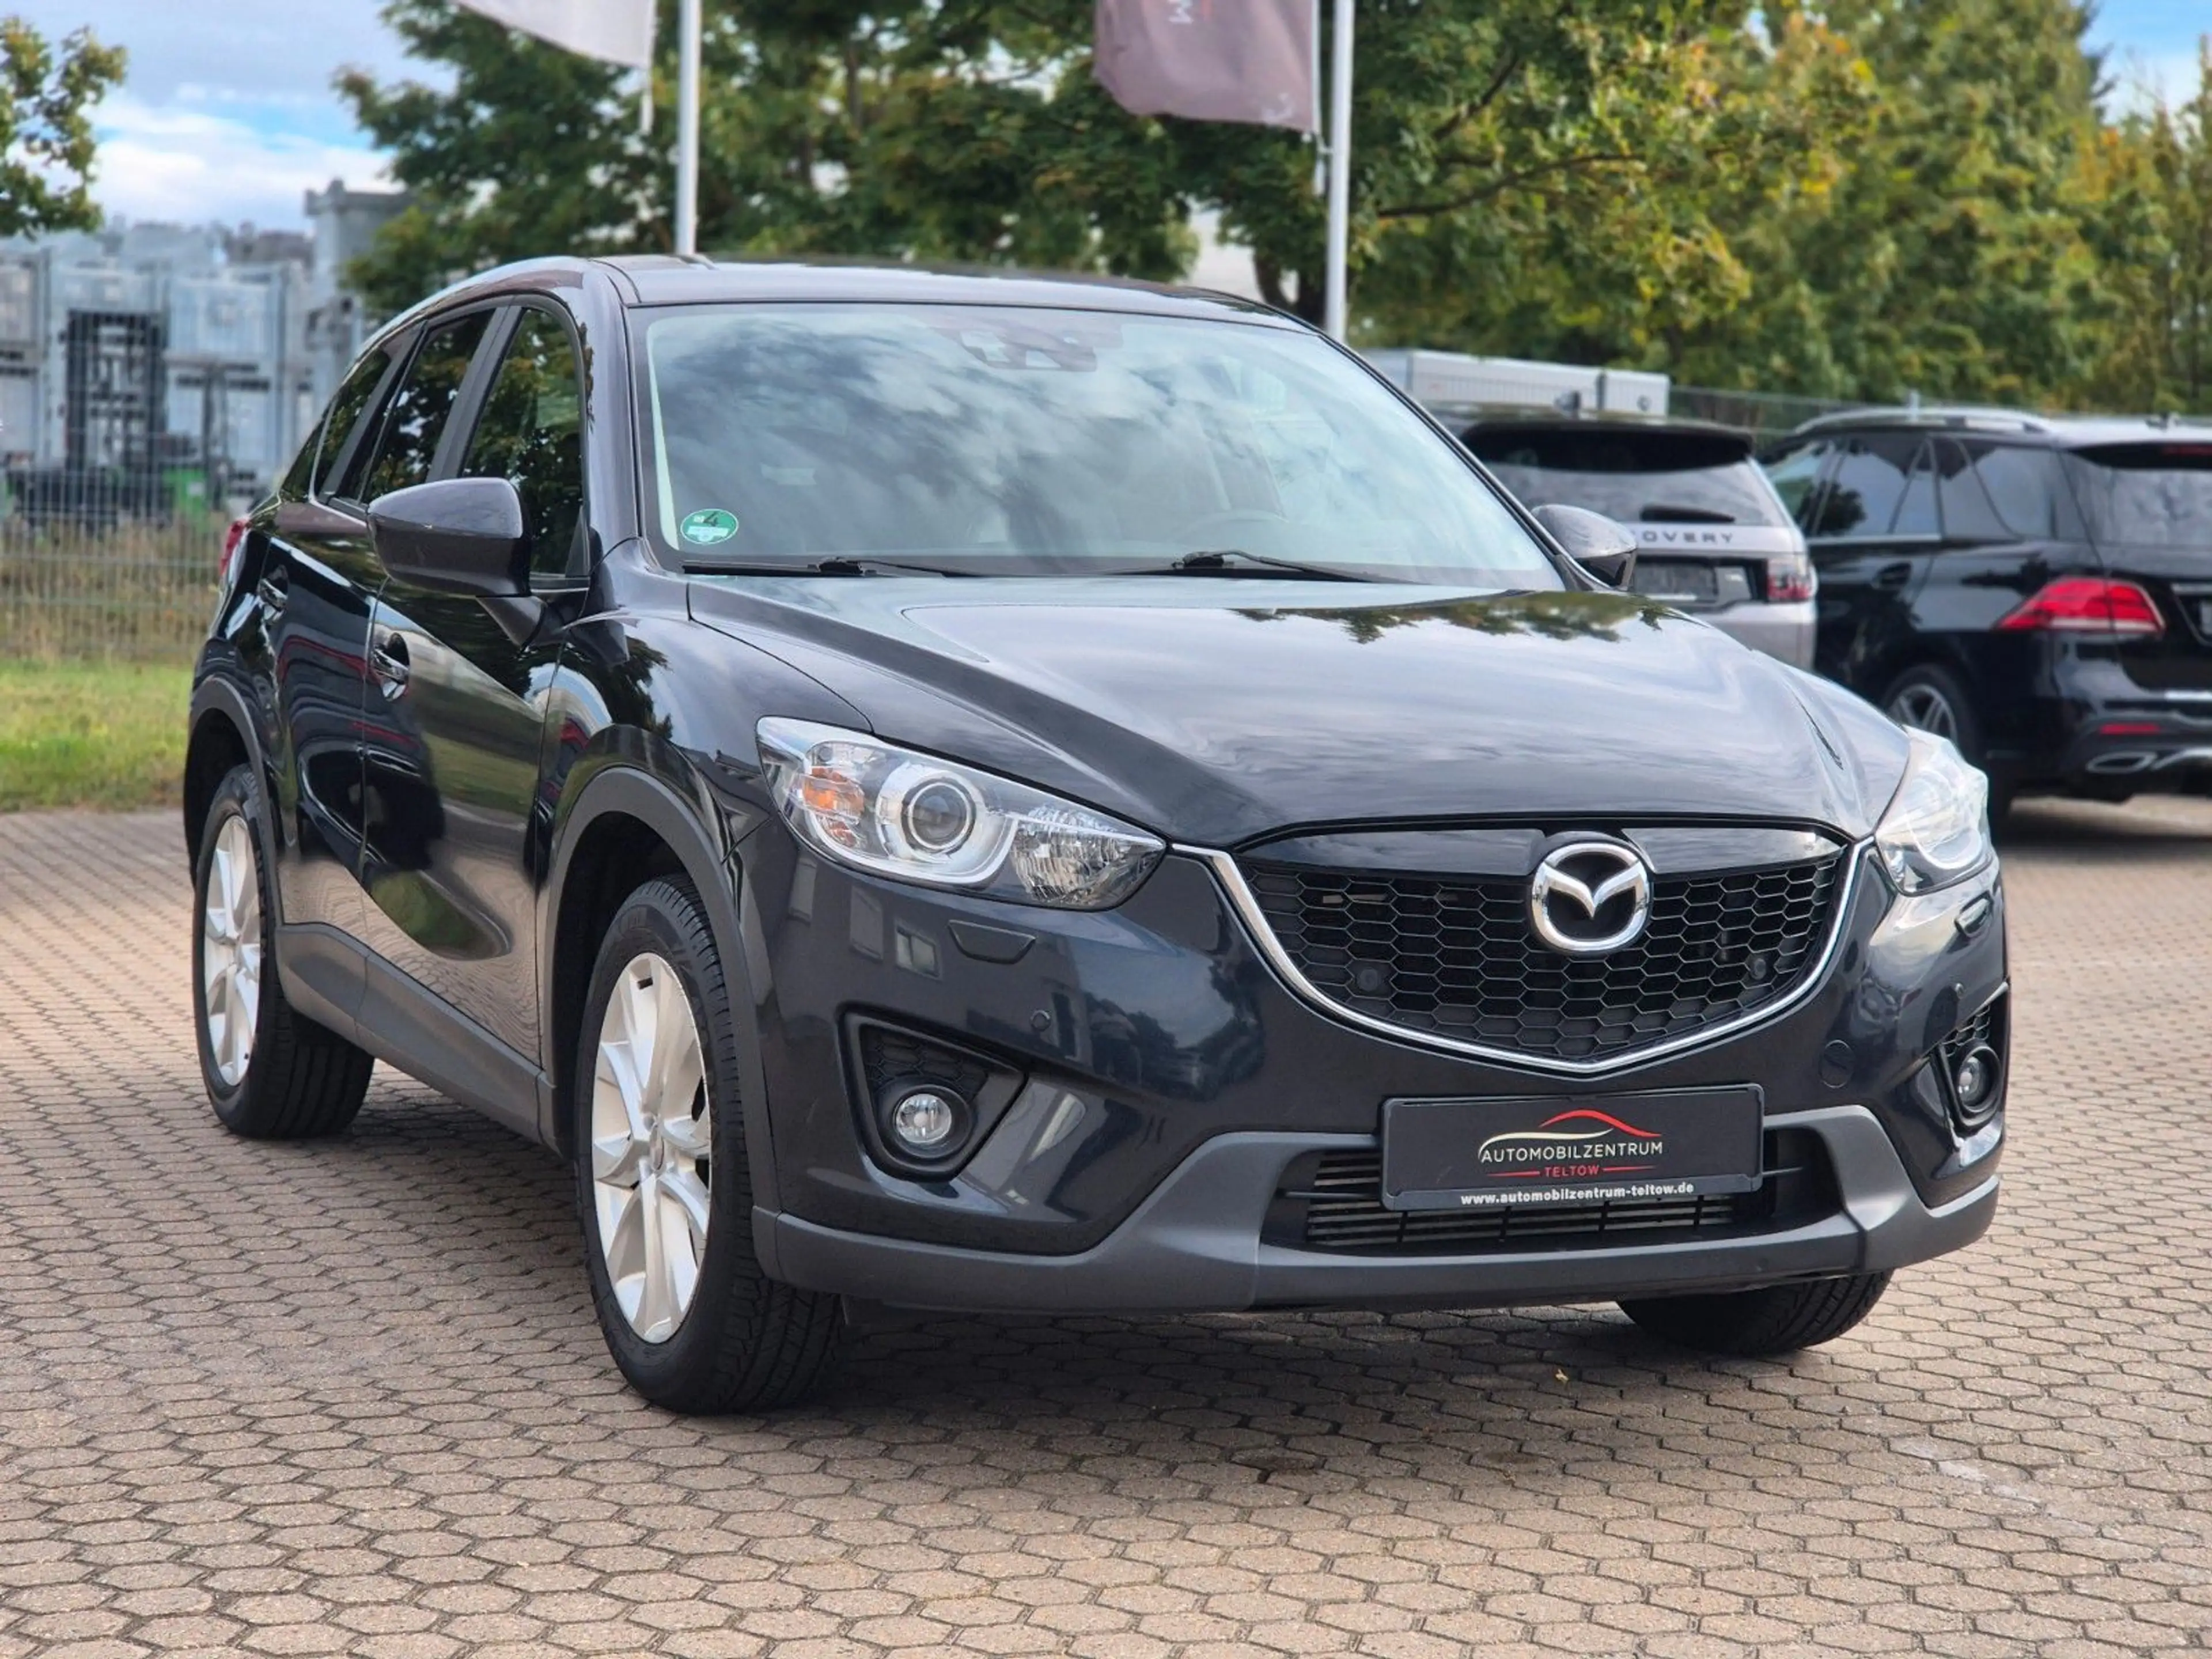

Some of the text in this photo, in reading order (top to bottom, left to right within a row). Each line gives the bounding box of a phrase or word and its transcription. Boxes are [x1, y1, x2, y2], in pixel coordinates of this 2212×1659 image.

[1630, 531, 1733, 544] OVERY
[1480, 1142, 1662, 1164] AUTOMOBILZENTRUM
[1544, 1165, 1599, 1177] TELTOW
[1461, 1181, 1694, 1205] www.automobilzentrum-teltow.de
